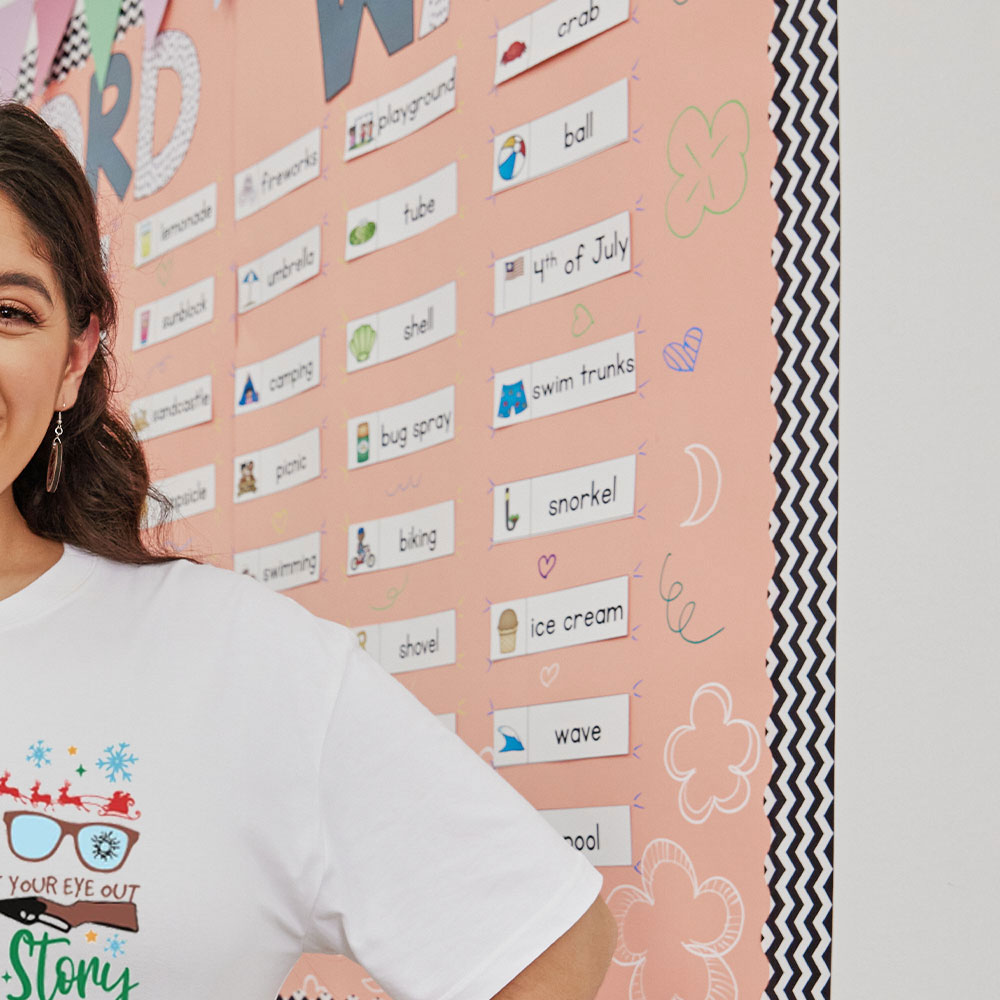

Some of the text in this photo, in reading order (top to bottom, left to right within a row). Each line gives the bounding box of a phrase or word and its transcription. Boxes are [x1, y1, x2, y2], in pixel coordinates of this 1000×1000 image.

[557, 0, 600, 38] crab
[378, 65, 456, 136] playground
[563, 110, 594, 149] ball
[261, 147, 317, 195] fireworks
[161, 200, 213, 241] lemonade
[404, 192, 435, 224] tube
[268, 247, 315, 288] umbrella
[533, 233, 629, 283] 4th of July
[162, 292, 206, 330] sunblock
[403, 306, 434, 340] shell
[269, 360, 314, 391] camping
[531, 356, 635, 400] swim trunks
[152, 386, 211, 422] sandcastle
[380, 410, 453, 449] bug spray
[276, 455, 308, 485] picnic
[548, 474, 617, 517] snorkel
[399, 528, 438, 553] biking
[263, 554, 317, 583] swimming
[530, 603, 624, 639] ice cream
[398, 627, 440, 660] shovel
[554, 722, 602, 746] wave
[8, 874, 57, 898] YOUR
[63, 877, 95, 898] EYE
[101, 883, 140, 903] OUT
